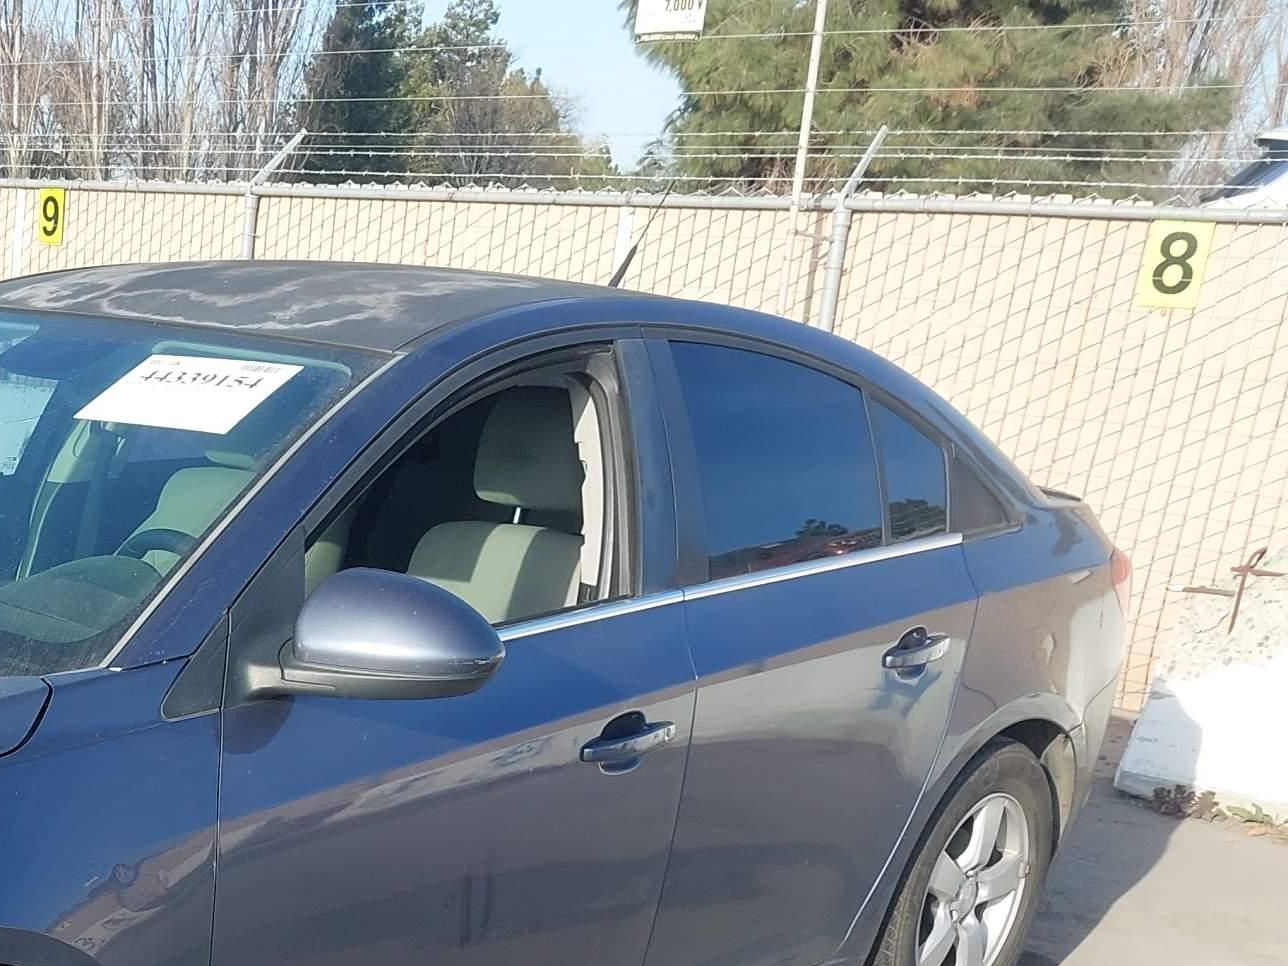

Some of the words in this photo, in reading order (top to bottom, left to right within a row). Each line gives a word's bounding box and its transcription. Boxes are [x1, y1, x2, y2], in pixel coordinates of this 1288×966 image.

[42, 195, 60, 237] 9
[1151, 231, 1199, 295] 8
[141, 369, 264, 390] 44339154
